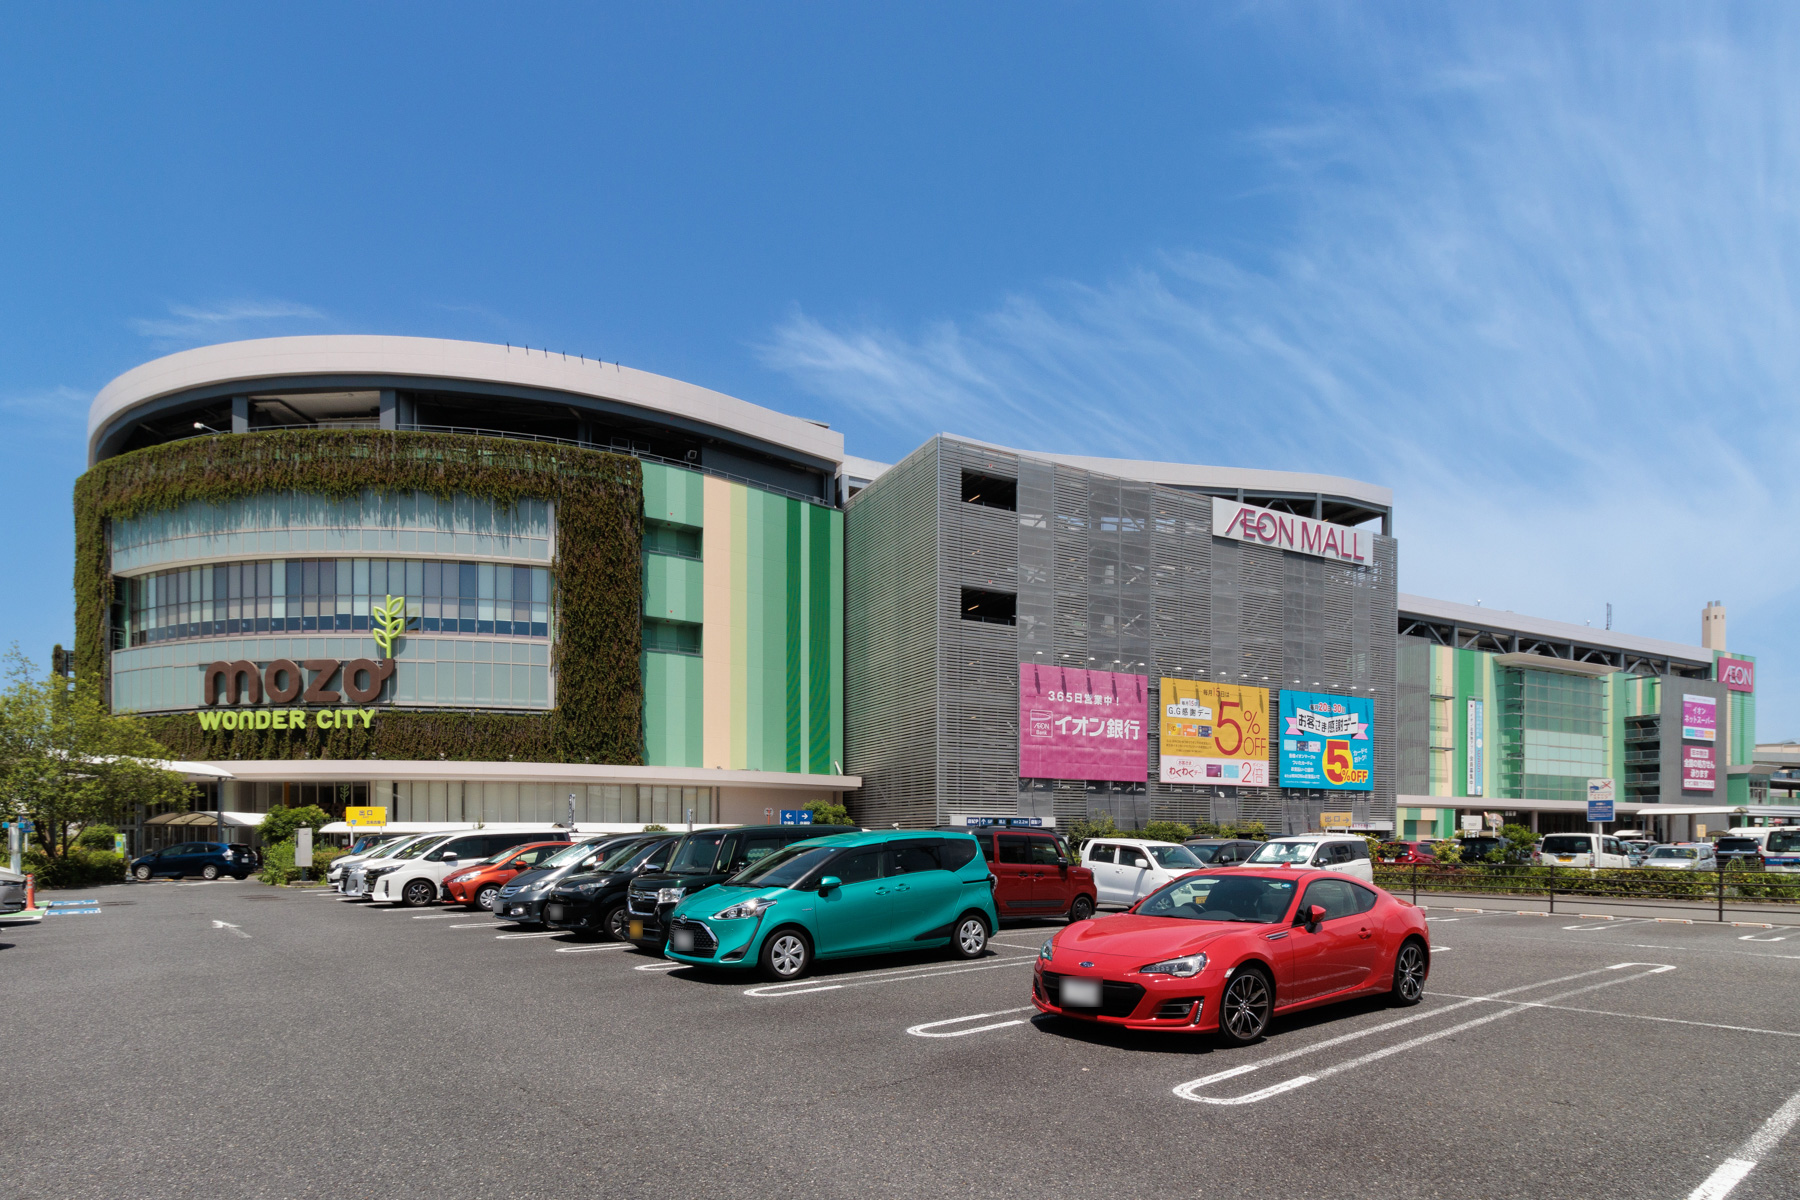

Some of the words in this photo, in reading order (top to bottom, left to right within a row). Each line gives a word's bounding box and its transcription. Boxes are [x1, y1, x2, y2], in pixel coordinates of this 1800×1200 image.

[1301, 521, 1364, 561] MALL
[204, 658, 394, 705] mozo
[1048, 690, 1119, 706] 365日営業中！
[198, 710, 306, 731] WONDER
[316, 709, 376, 729] CITY
[1168, 706, 1211, 717] G.G感謝デー
[1055, 716, 1140, 740] イオン銀行
[1298, 713, 1357, 734] お客さま感謝デー
[1168, 766, 1202, 778] わくわくデー
